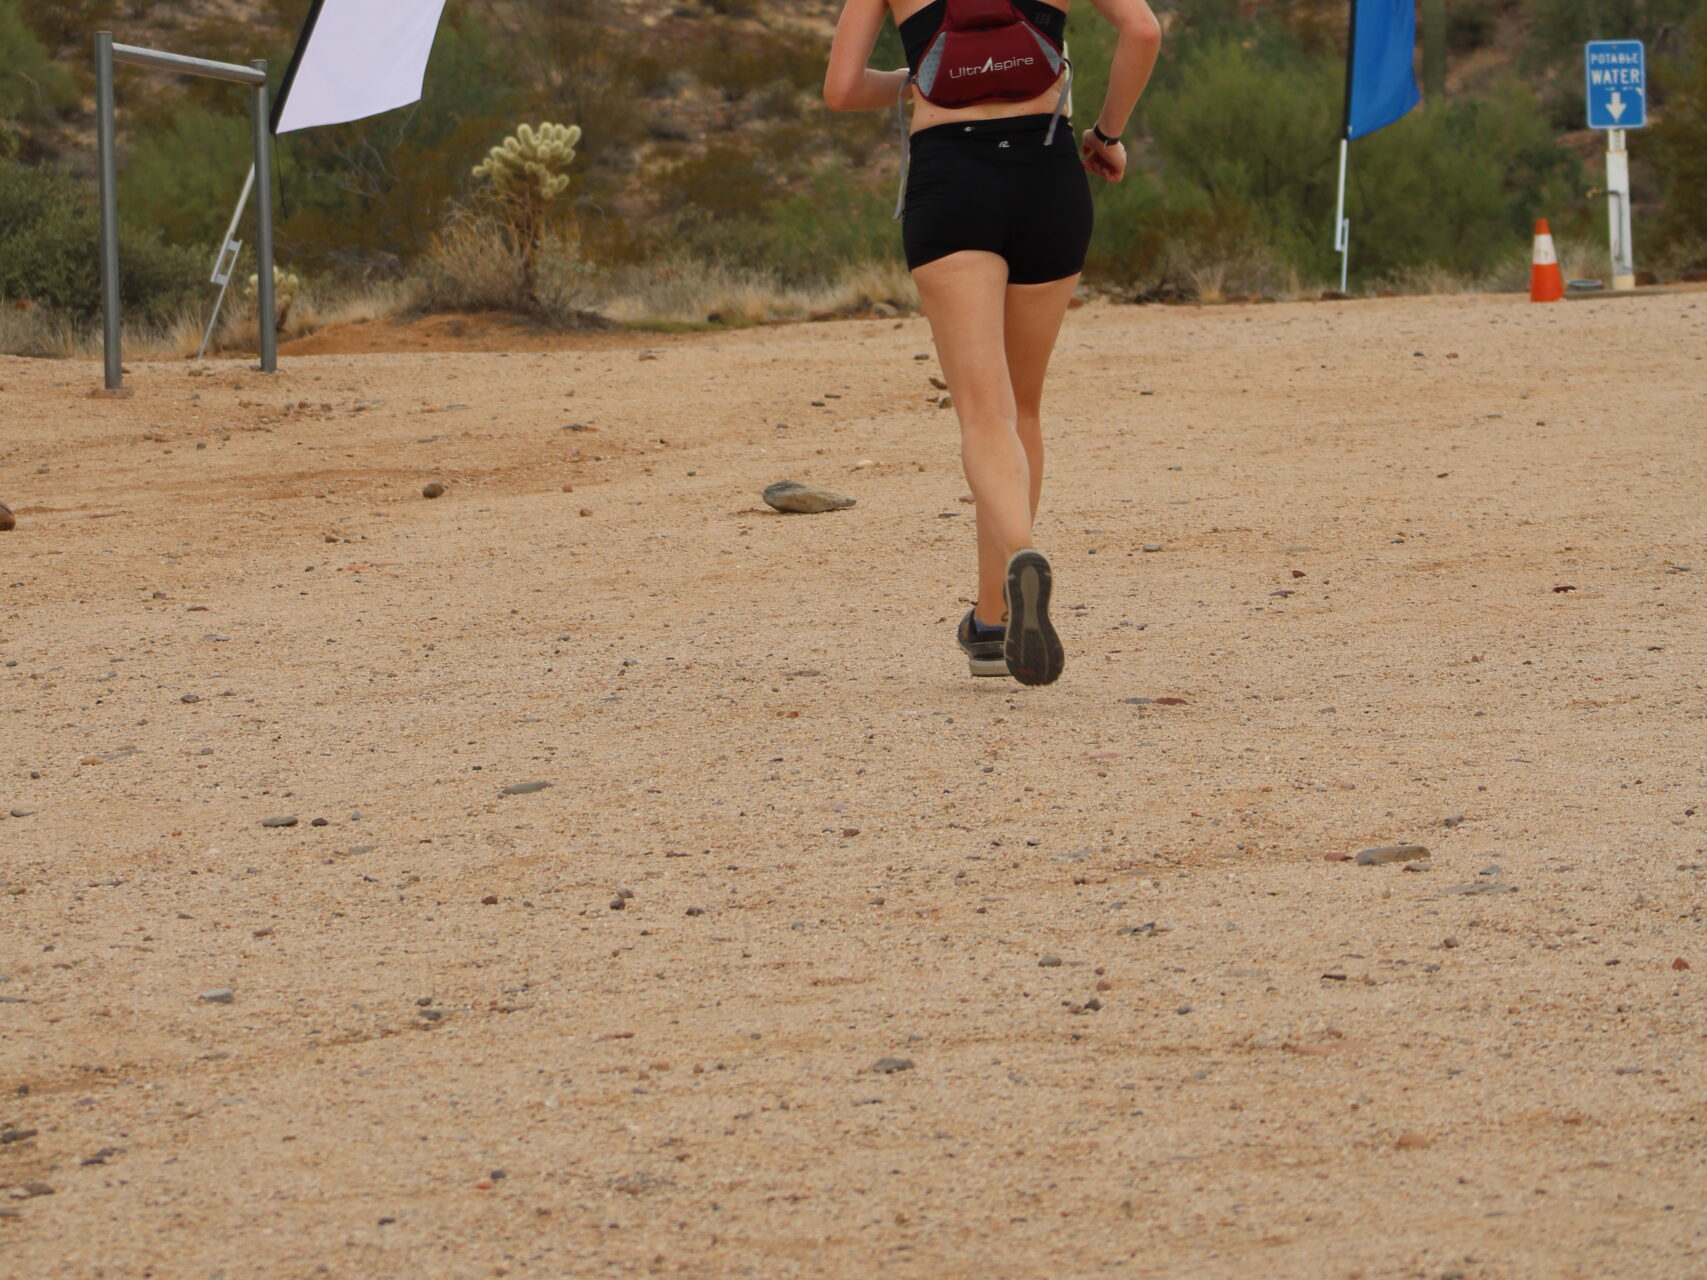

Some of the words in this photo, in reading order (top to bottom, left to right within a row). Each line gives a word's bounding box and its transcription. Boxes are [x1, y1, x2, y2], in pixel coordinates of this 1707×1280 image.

[1590, 52, 1639, 65] POTABLE
[949, 56, 1034, 79] UltrAspire
[1591, 68, 1640, 85] WATER
